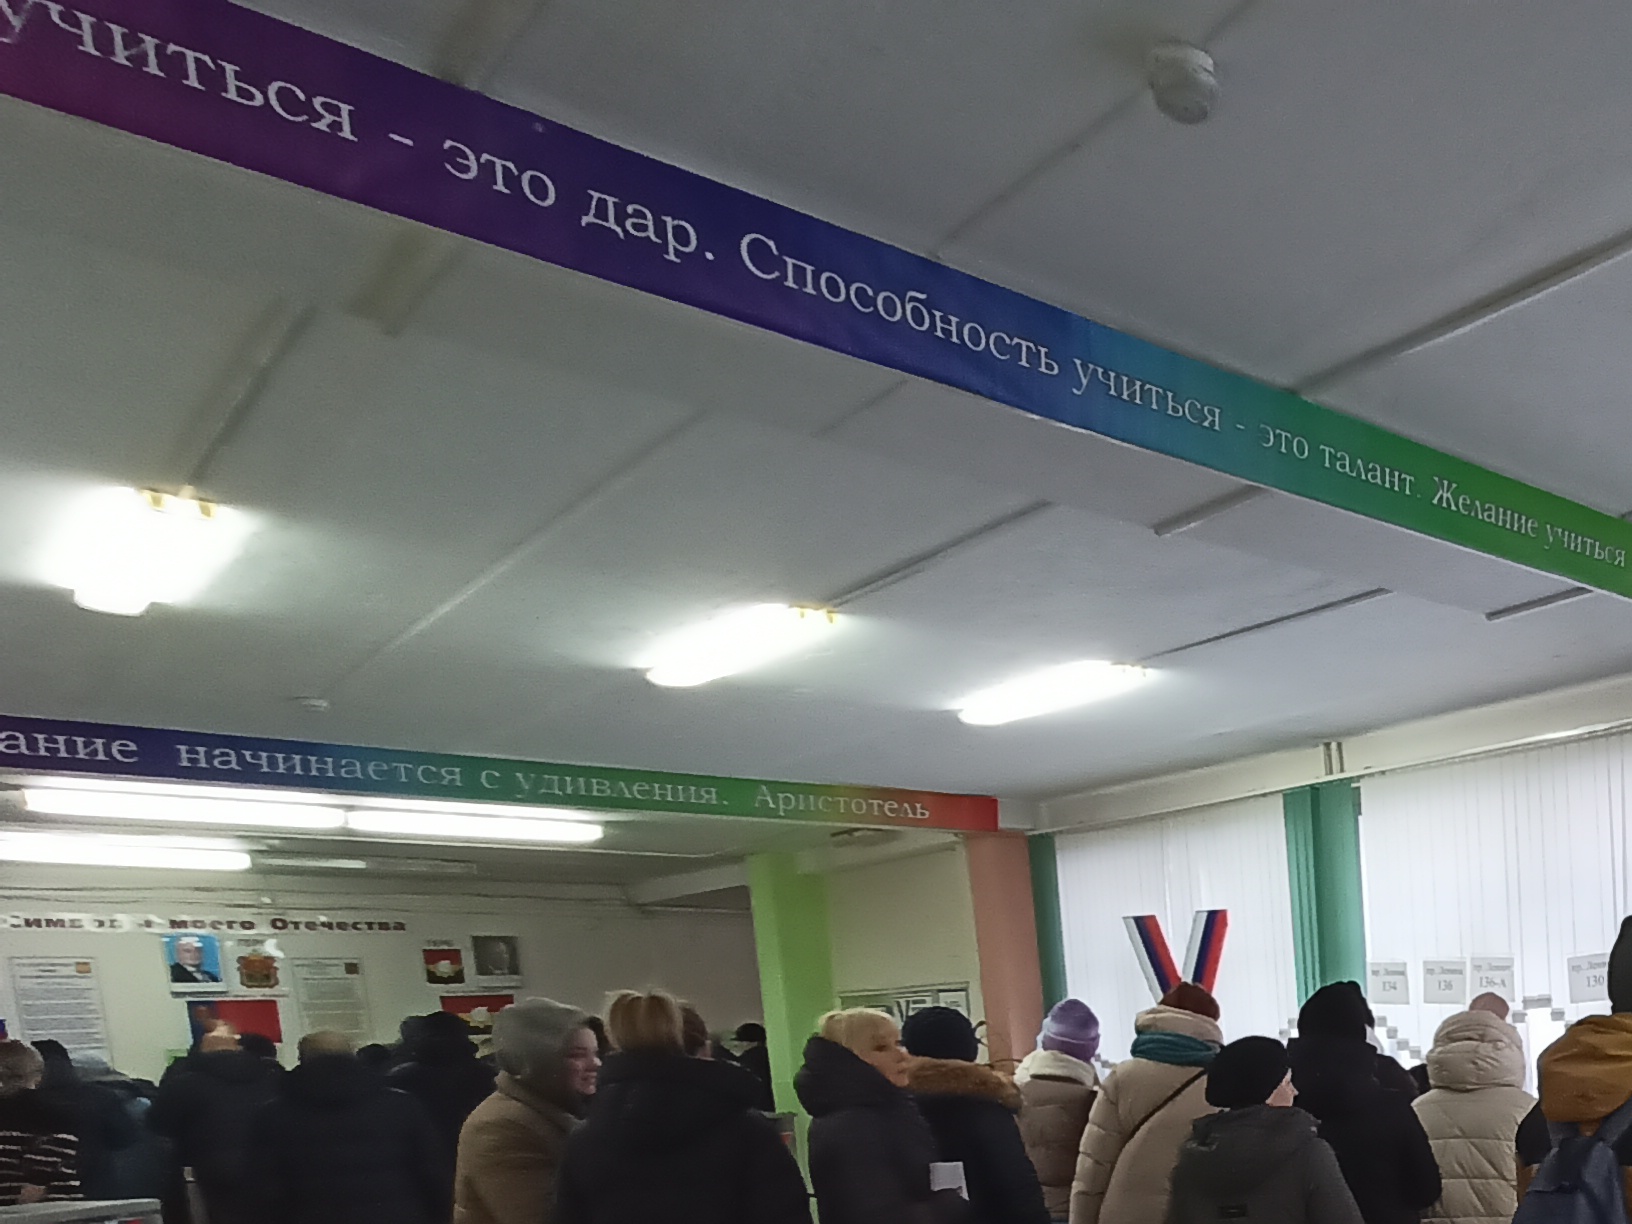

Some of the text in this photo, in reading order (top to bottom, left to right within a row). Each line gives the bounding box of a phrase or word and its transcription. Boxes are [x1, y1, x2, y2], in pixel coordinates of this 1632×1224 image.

[0, 0, 358, 142] учиться
[442, 139, 557, 207] это
[580, 189, 715, 263] дар.
[739, 232, 1060, 376] Способность
[1071, 357, 1222, 432] учиться
[1258, 423, 1309, 460] это
[1319, 444, 1422, 498] талант.
[1431, 475, 1539, 538] Желание
[1543, 522, 1626, 568] учиться
[174, 742, 465, 787] начинается
[479, 769, 502, 790] с
[514, 770, 730, 807] удивления.
[753, 783, 931, 820] Аристотель
[168, 918, 256, 931] моего
[270, 916, 407, 932] Отечества
[1437, 980, 1454, 991] 136
[1586, 975, 1605, 989] 130
